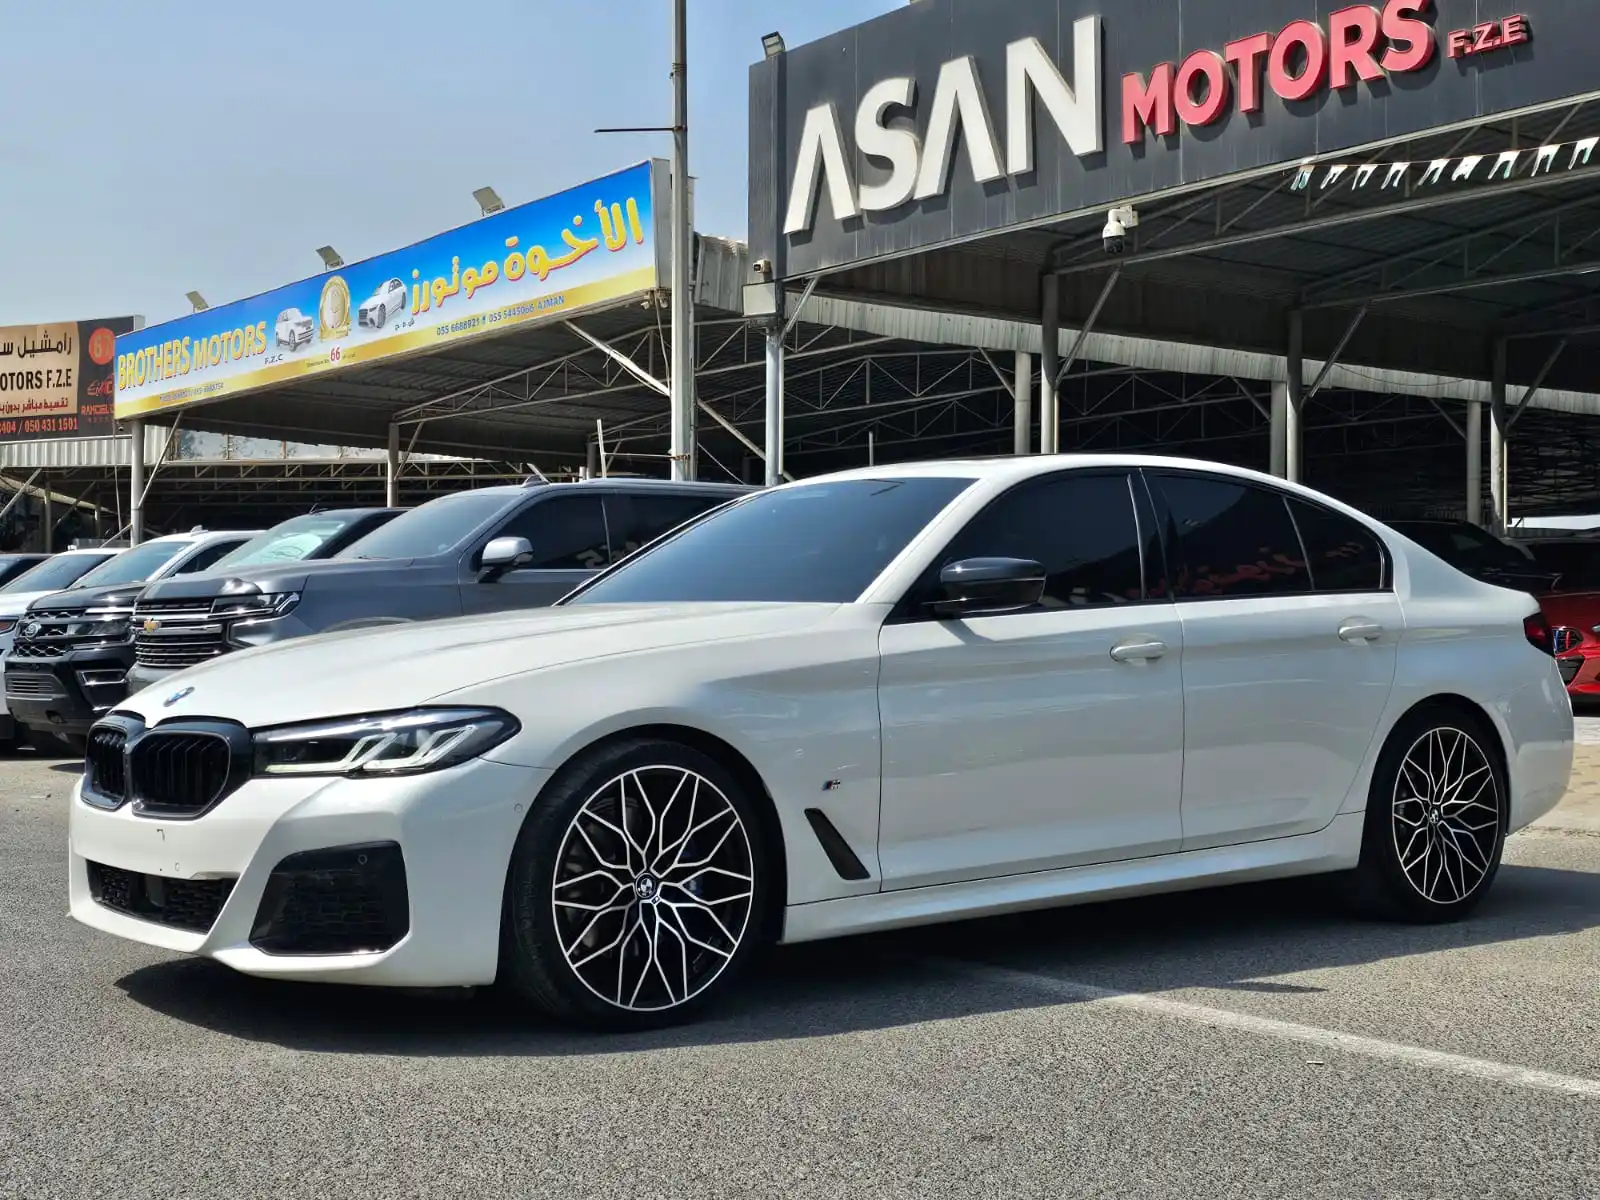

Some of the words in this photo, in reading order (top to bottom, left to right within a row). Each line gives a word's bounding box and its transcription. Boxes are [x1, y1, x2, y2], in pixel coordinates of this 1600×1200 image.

[1121, 0, 1436, 145] MOTORS
[1447, 14, 1528, 59] F.Z.E
[783, 14, 1103, 234] ASAN
[503, 197, 644, 282] الأخوة
[411, 256, 499, 315] موتورز
[17, 330, 72, 359] رامشيل
[436, 323, 450, 337] 055
[488, 310, 502, 323] 055
[537, 295, 565, 311] AJMAN
[46, 368, 72, 389] F.Z.E
[117, 336, 191, 391] BROTHERS
[193, 320, 267, 371] MOTORS
[330, 347, 341, 361] 66
